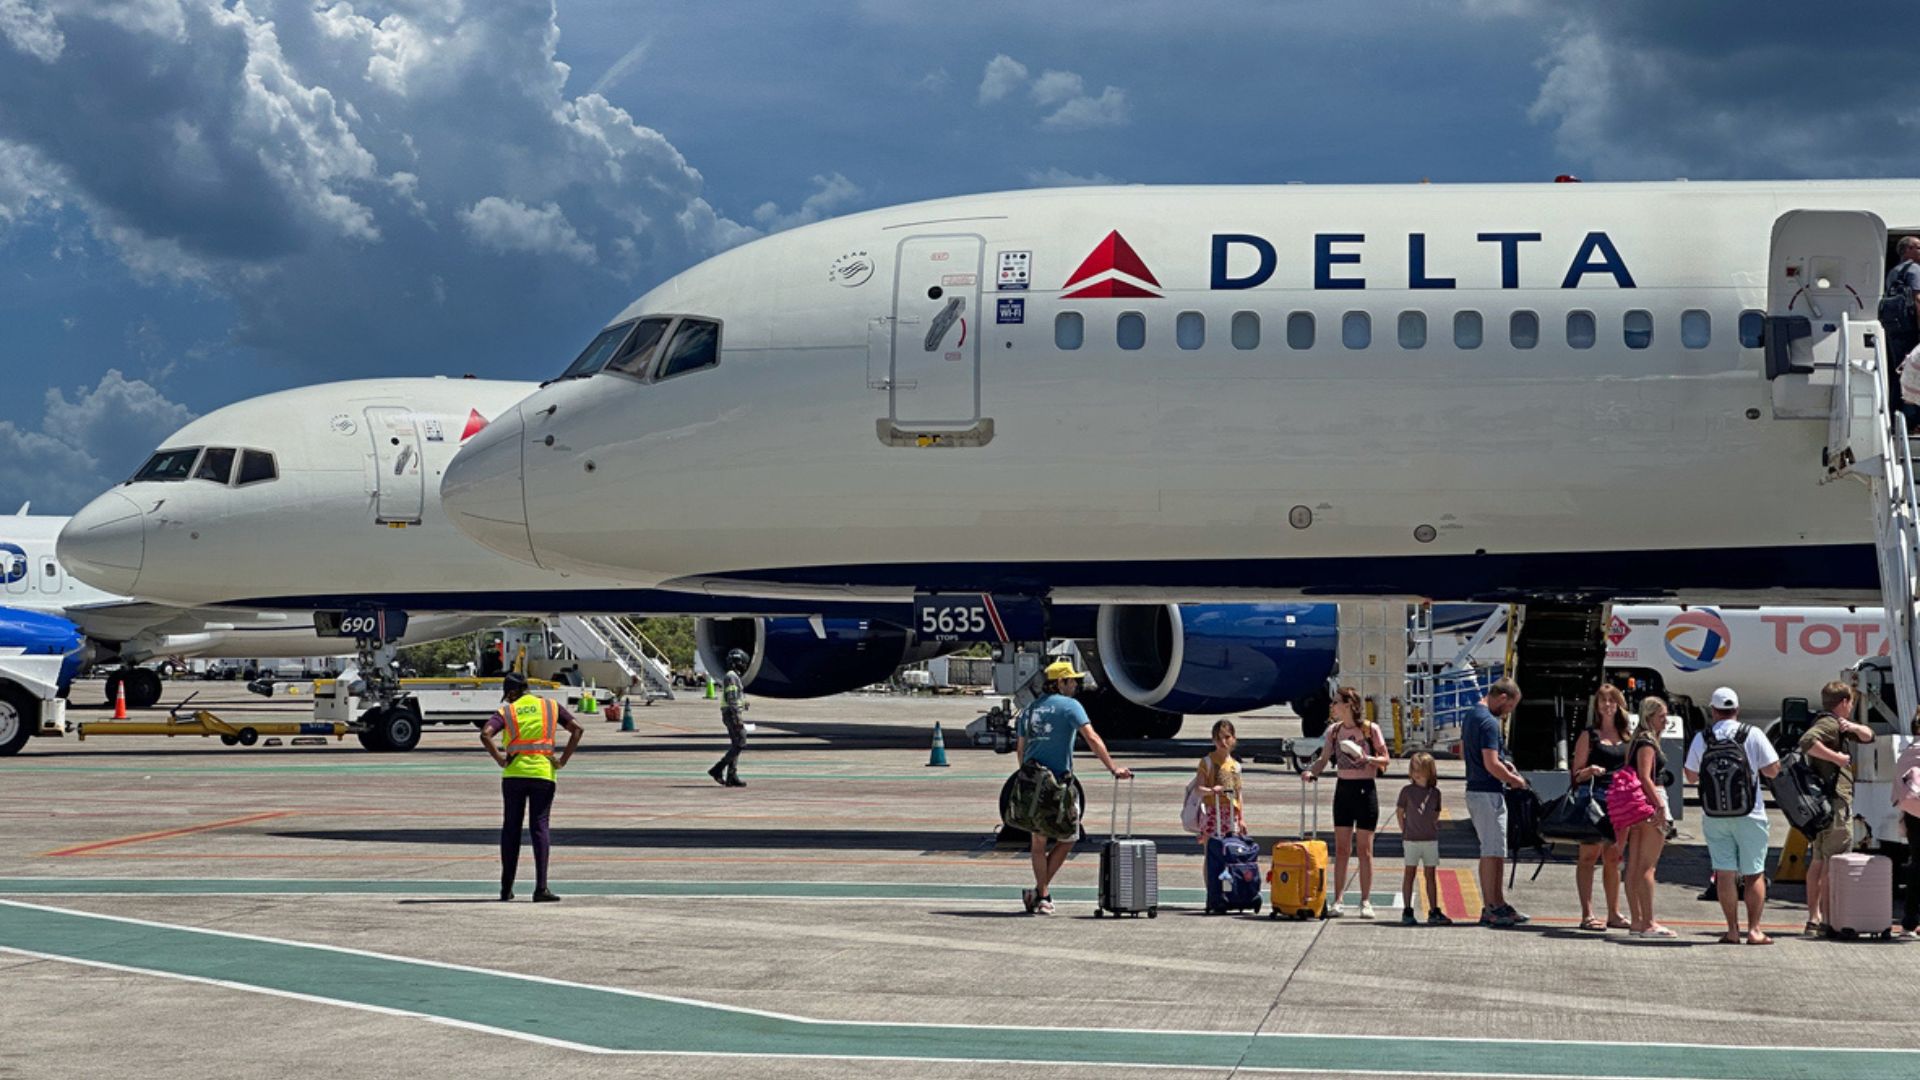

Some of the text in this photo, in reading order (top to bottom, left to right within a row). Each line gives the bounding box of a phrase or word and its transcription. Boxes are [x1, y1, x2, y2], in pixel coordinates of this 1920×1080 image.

[1210, 231, 1637, 290] DELTA
[341, 617, 375, 633] 690
[922, 606, 986, 633] 5635
[1760, 615, 1890, 657] TOT
